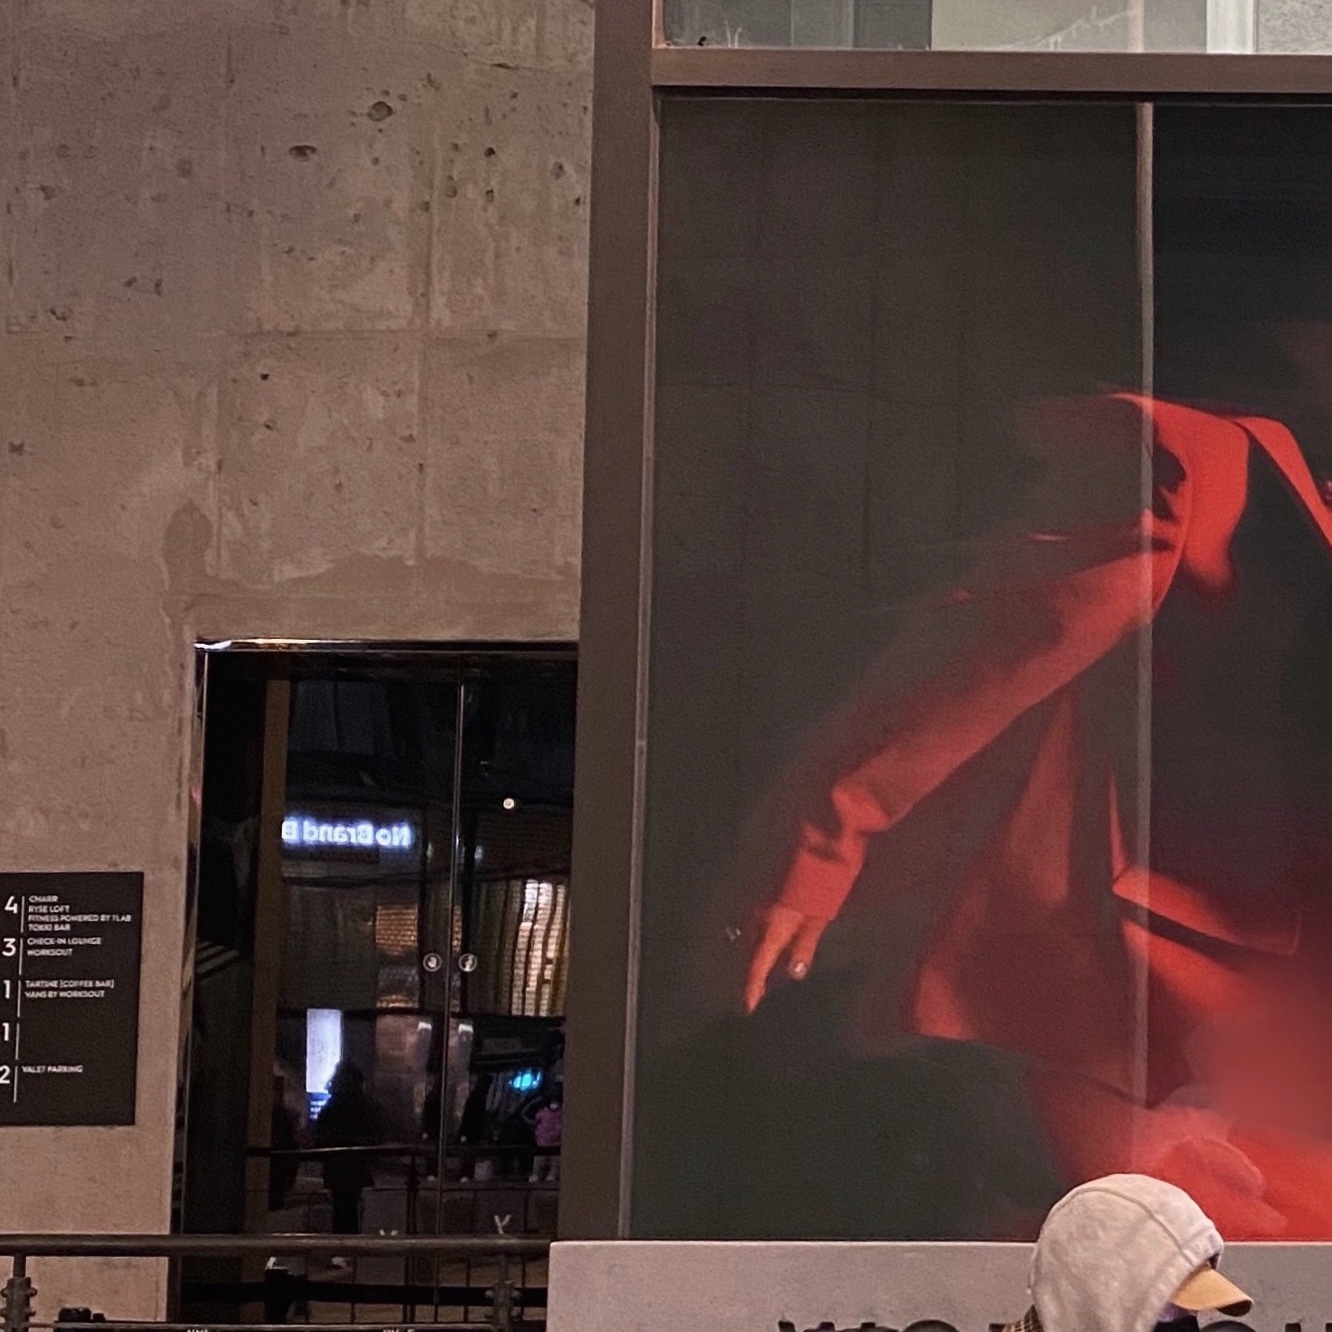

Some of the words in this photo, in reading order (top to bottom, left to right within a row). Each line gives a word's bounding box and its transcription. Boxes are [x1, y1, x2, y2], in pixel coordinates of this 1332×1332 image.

[4, 895, 18, 914] 4
[49, 905, 70, 913] LOFT
[60, 914, 99, 922] POWERED
[101, 914, 111, 922] BY
[54, 923, 70, 931] BAR
[68, 937, 101, 945] LOUNGE
[2, 938, 16, 957] 3
[0, 1065, 11, 1084] 2
